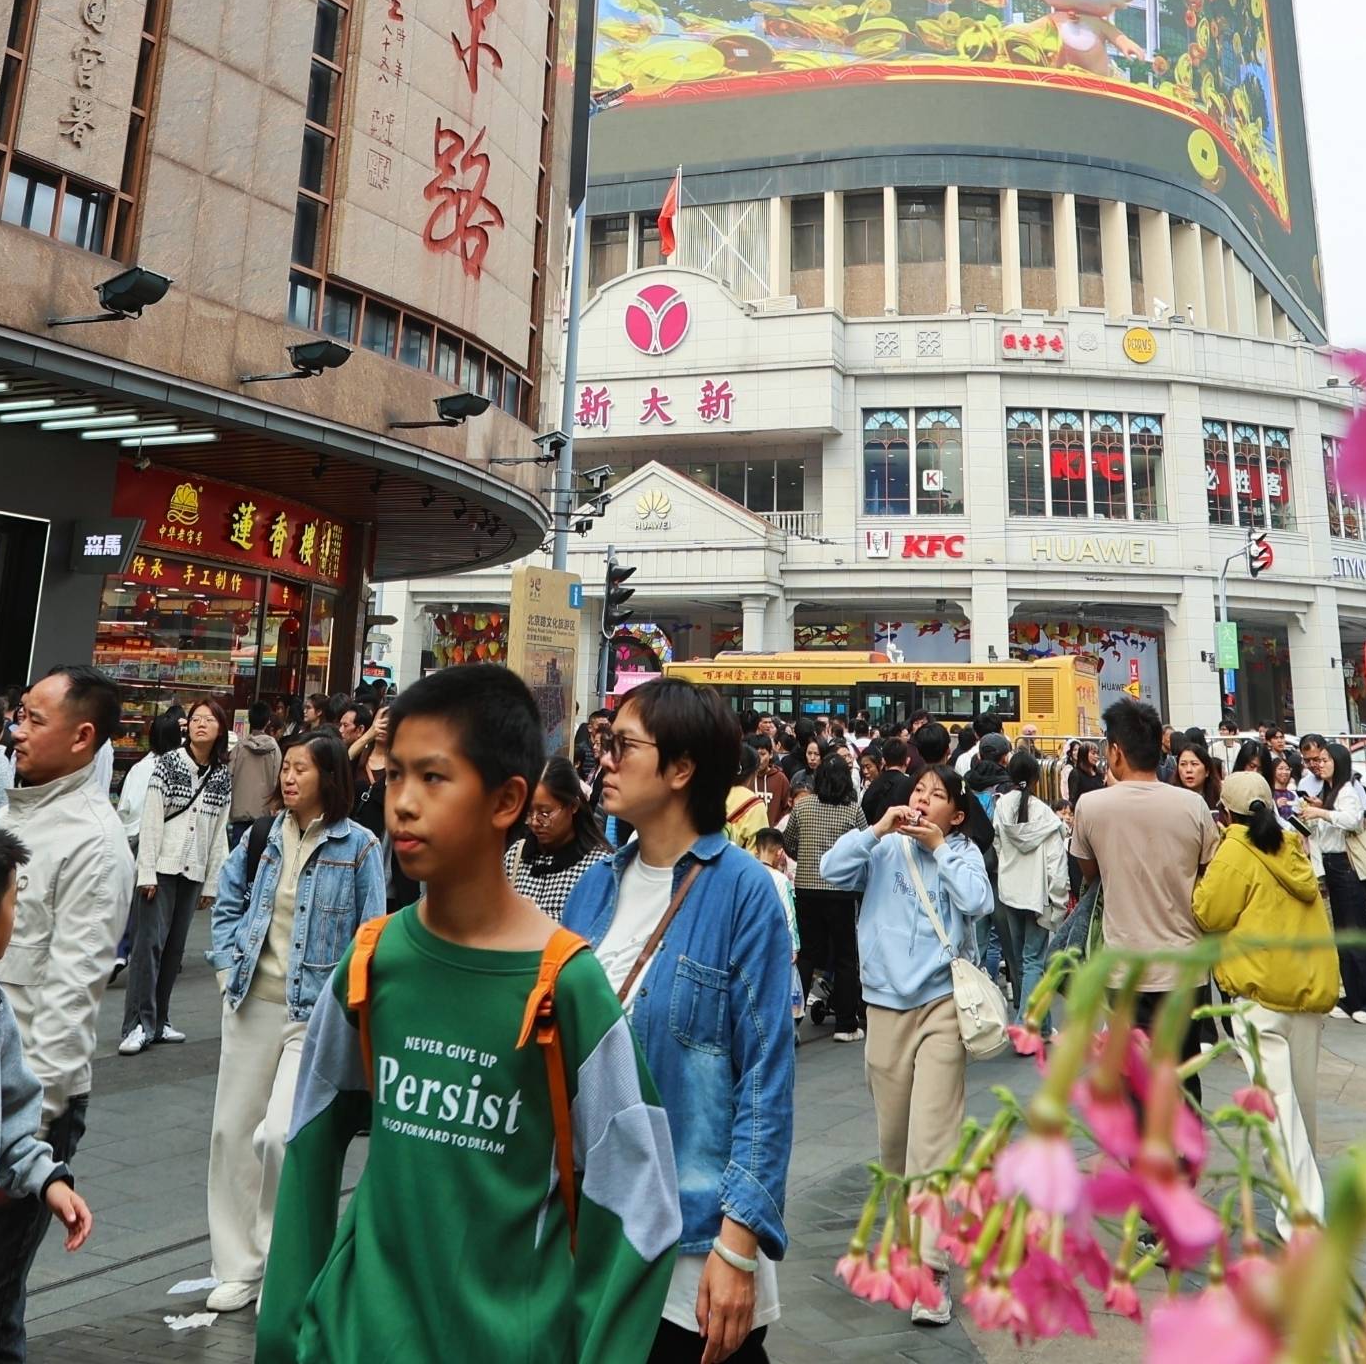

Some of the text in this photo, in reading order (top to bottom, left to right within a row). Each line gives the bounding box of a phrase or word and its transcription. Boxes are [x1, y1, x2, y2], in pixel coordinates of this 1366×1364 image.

[573, 377, 736, 433] 新大新
[1050, 450, 1127, 483] KFC
[1205, 463, 1284, 498] 必胜客
[158, 523, 204, 547] 中华老字号
[634, 520, 672, 531] HUAWEI
[83, 533, 124, 557] 森馬
[901, 534, 966, 559] KFC
[1030, 534, 1157, 566] HUAWEI
[182, 564, 243, 594] 手工制作
[1101, 681, 1125, 692] HUAWE
[403, 1035, 499, 1069] NEVER GIVE UP
[377, 1055, 524, 1136] Persist
[388, 1119, 402, 1133] GO
[401, 1121, 449, 1144] FORWARD
[451, 1133, 468, 1148] TO
[467, 1136, 506, 1156] DREAM
